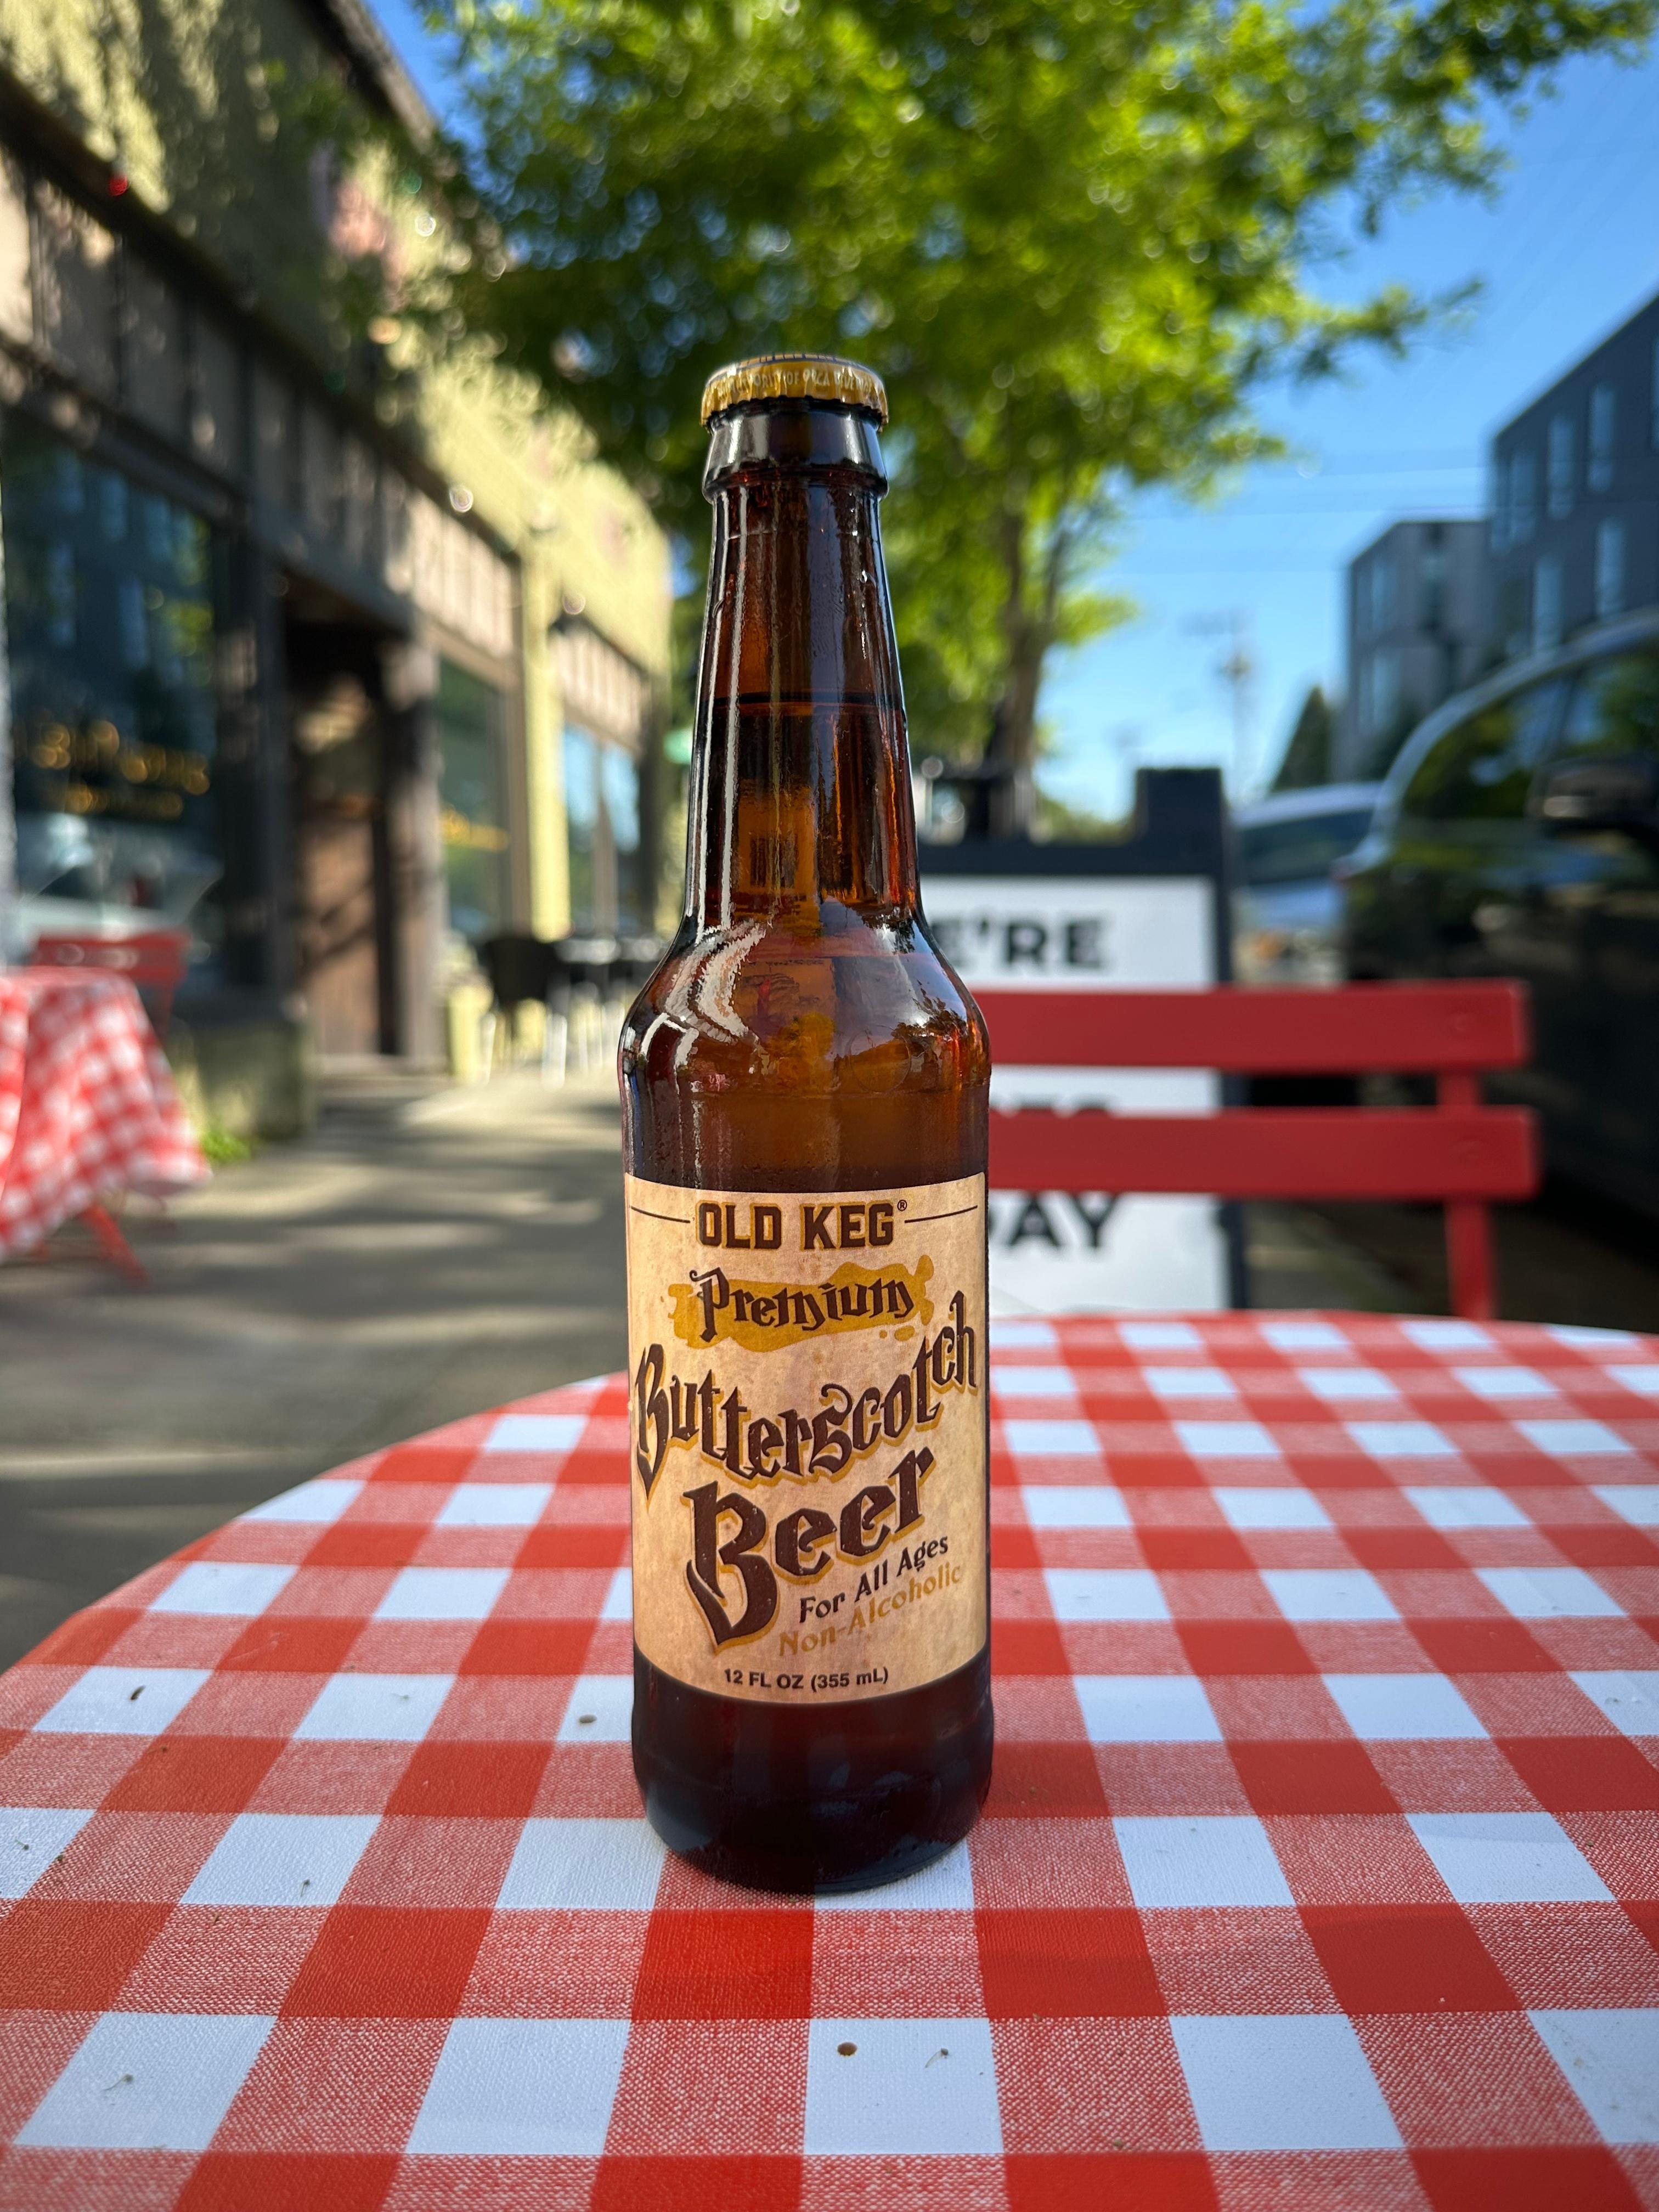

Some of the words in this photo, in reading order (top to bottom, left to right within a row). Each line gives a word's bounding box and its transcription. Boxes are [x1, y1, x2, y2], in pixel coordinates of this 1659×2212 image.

[786, 371, 800, 385] OF
[803, 368, 830, 387] ORCA
[928, 918, 1107, 968] E'RE
[696, 1200, 783, 1251] OLD
[989, 1193, 1119, 1249] AY
[690, 1267, 914, 1343] Premium
[634, 1289, 979, 1502] Butterscotch
[680, 1444, 935, 1654] Beer
[799, 1590, 846, 1623] For
[854, 1566, 889, 1602] All
[896, 1536, 950, 1578] Ages
[777, 1562, 963, 1657] Non-Alcoholic
[723, 1668, 743, 1685] 12
[749, 1672, 772, 1688] FL
[776, 1673, 804, 1690] OZ
[810, 1671, 850, 1692] (355
[855, 1666, 889, 1686] mL)
